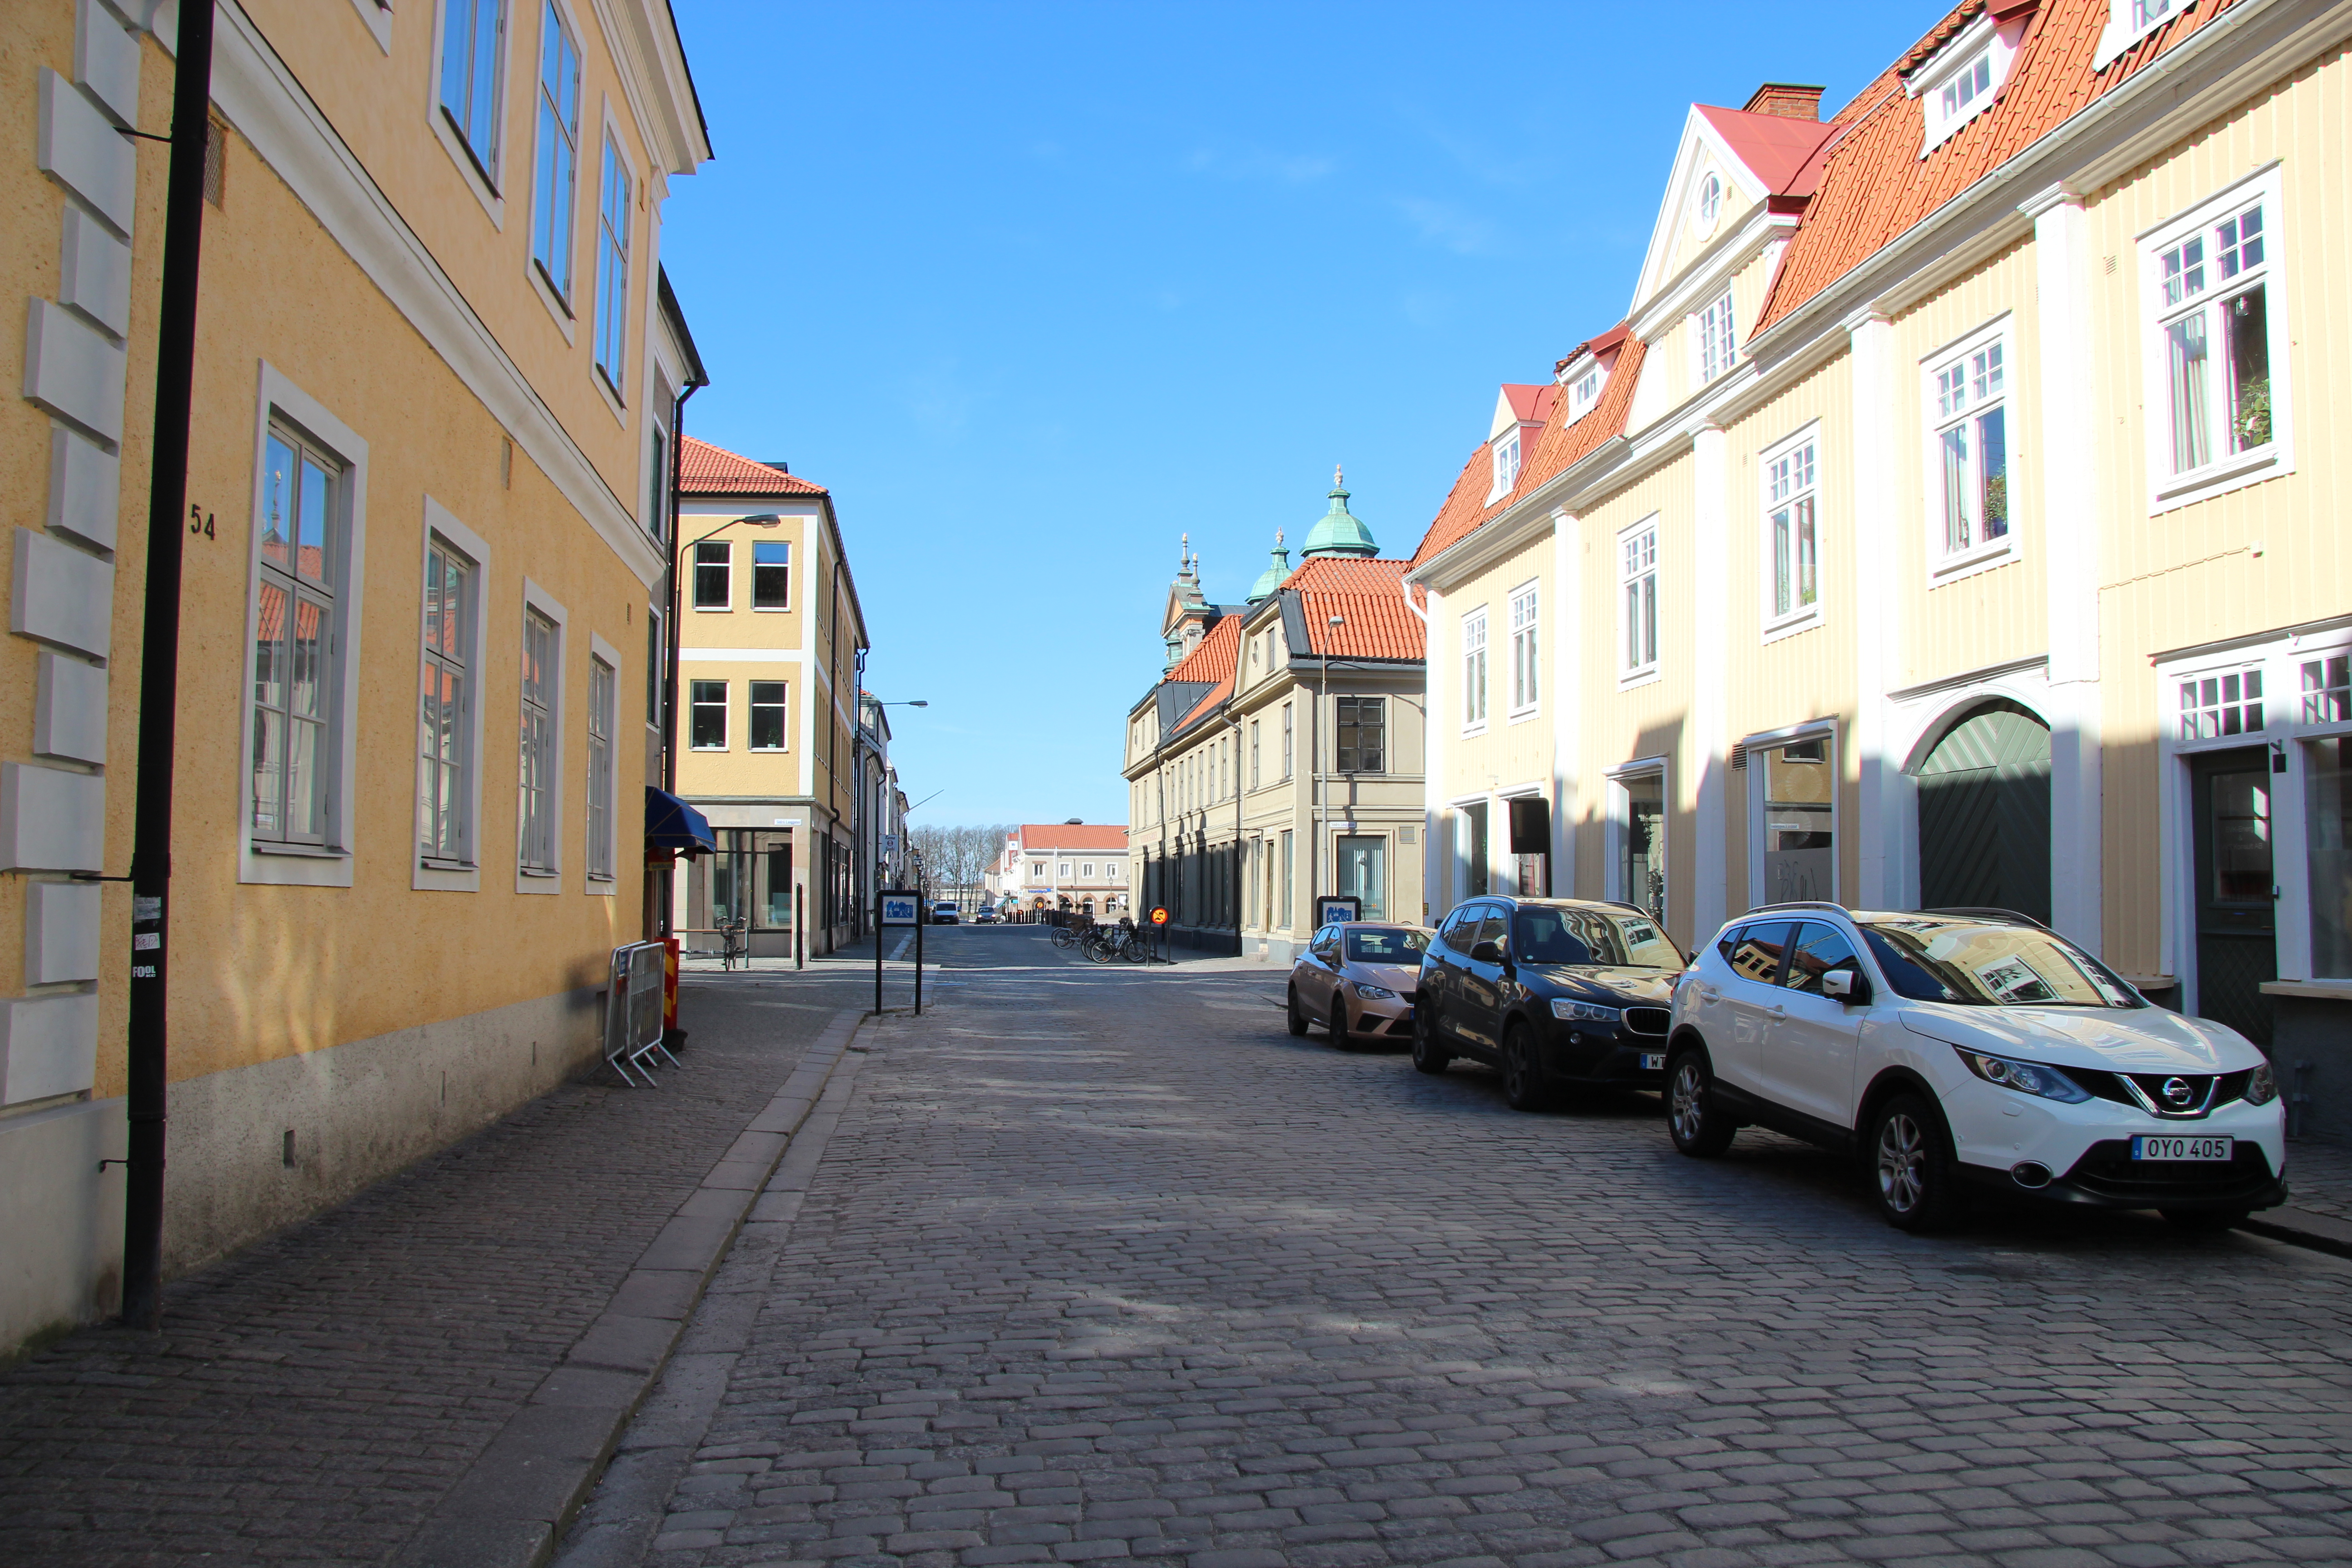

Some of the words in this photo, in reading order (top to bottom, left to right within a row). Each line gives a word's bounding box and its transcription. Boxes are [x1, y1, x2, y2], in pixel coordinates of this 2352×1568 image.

[191, 504, 216, 540] 54
[133, 965, 156, 977] FOOL
[1651, 1056, 1666, 1067] WT
[2148, 1139, 2184, 1157] OYO
[2189, 1139, 2224, 1158] 405
